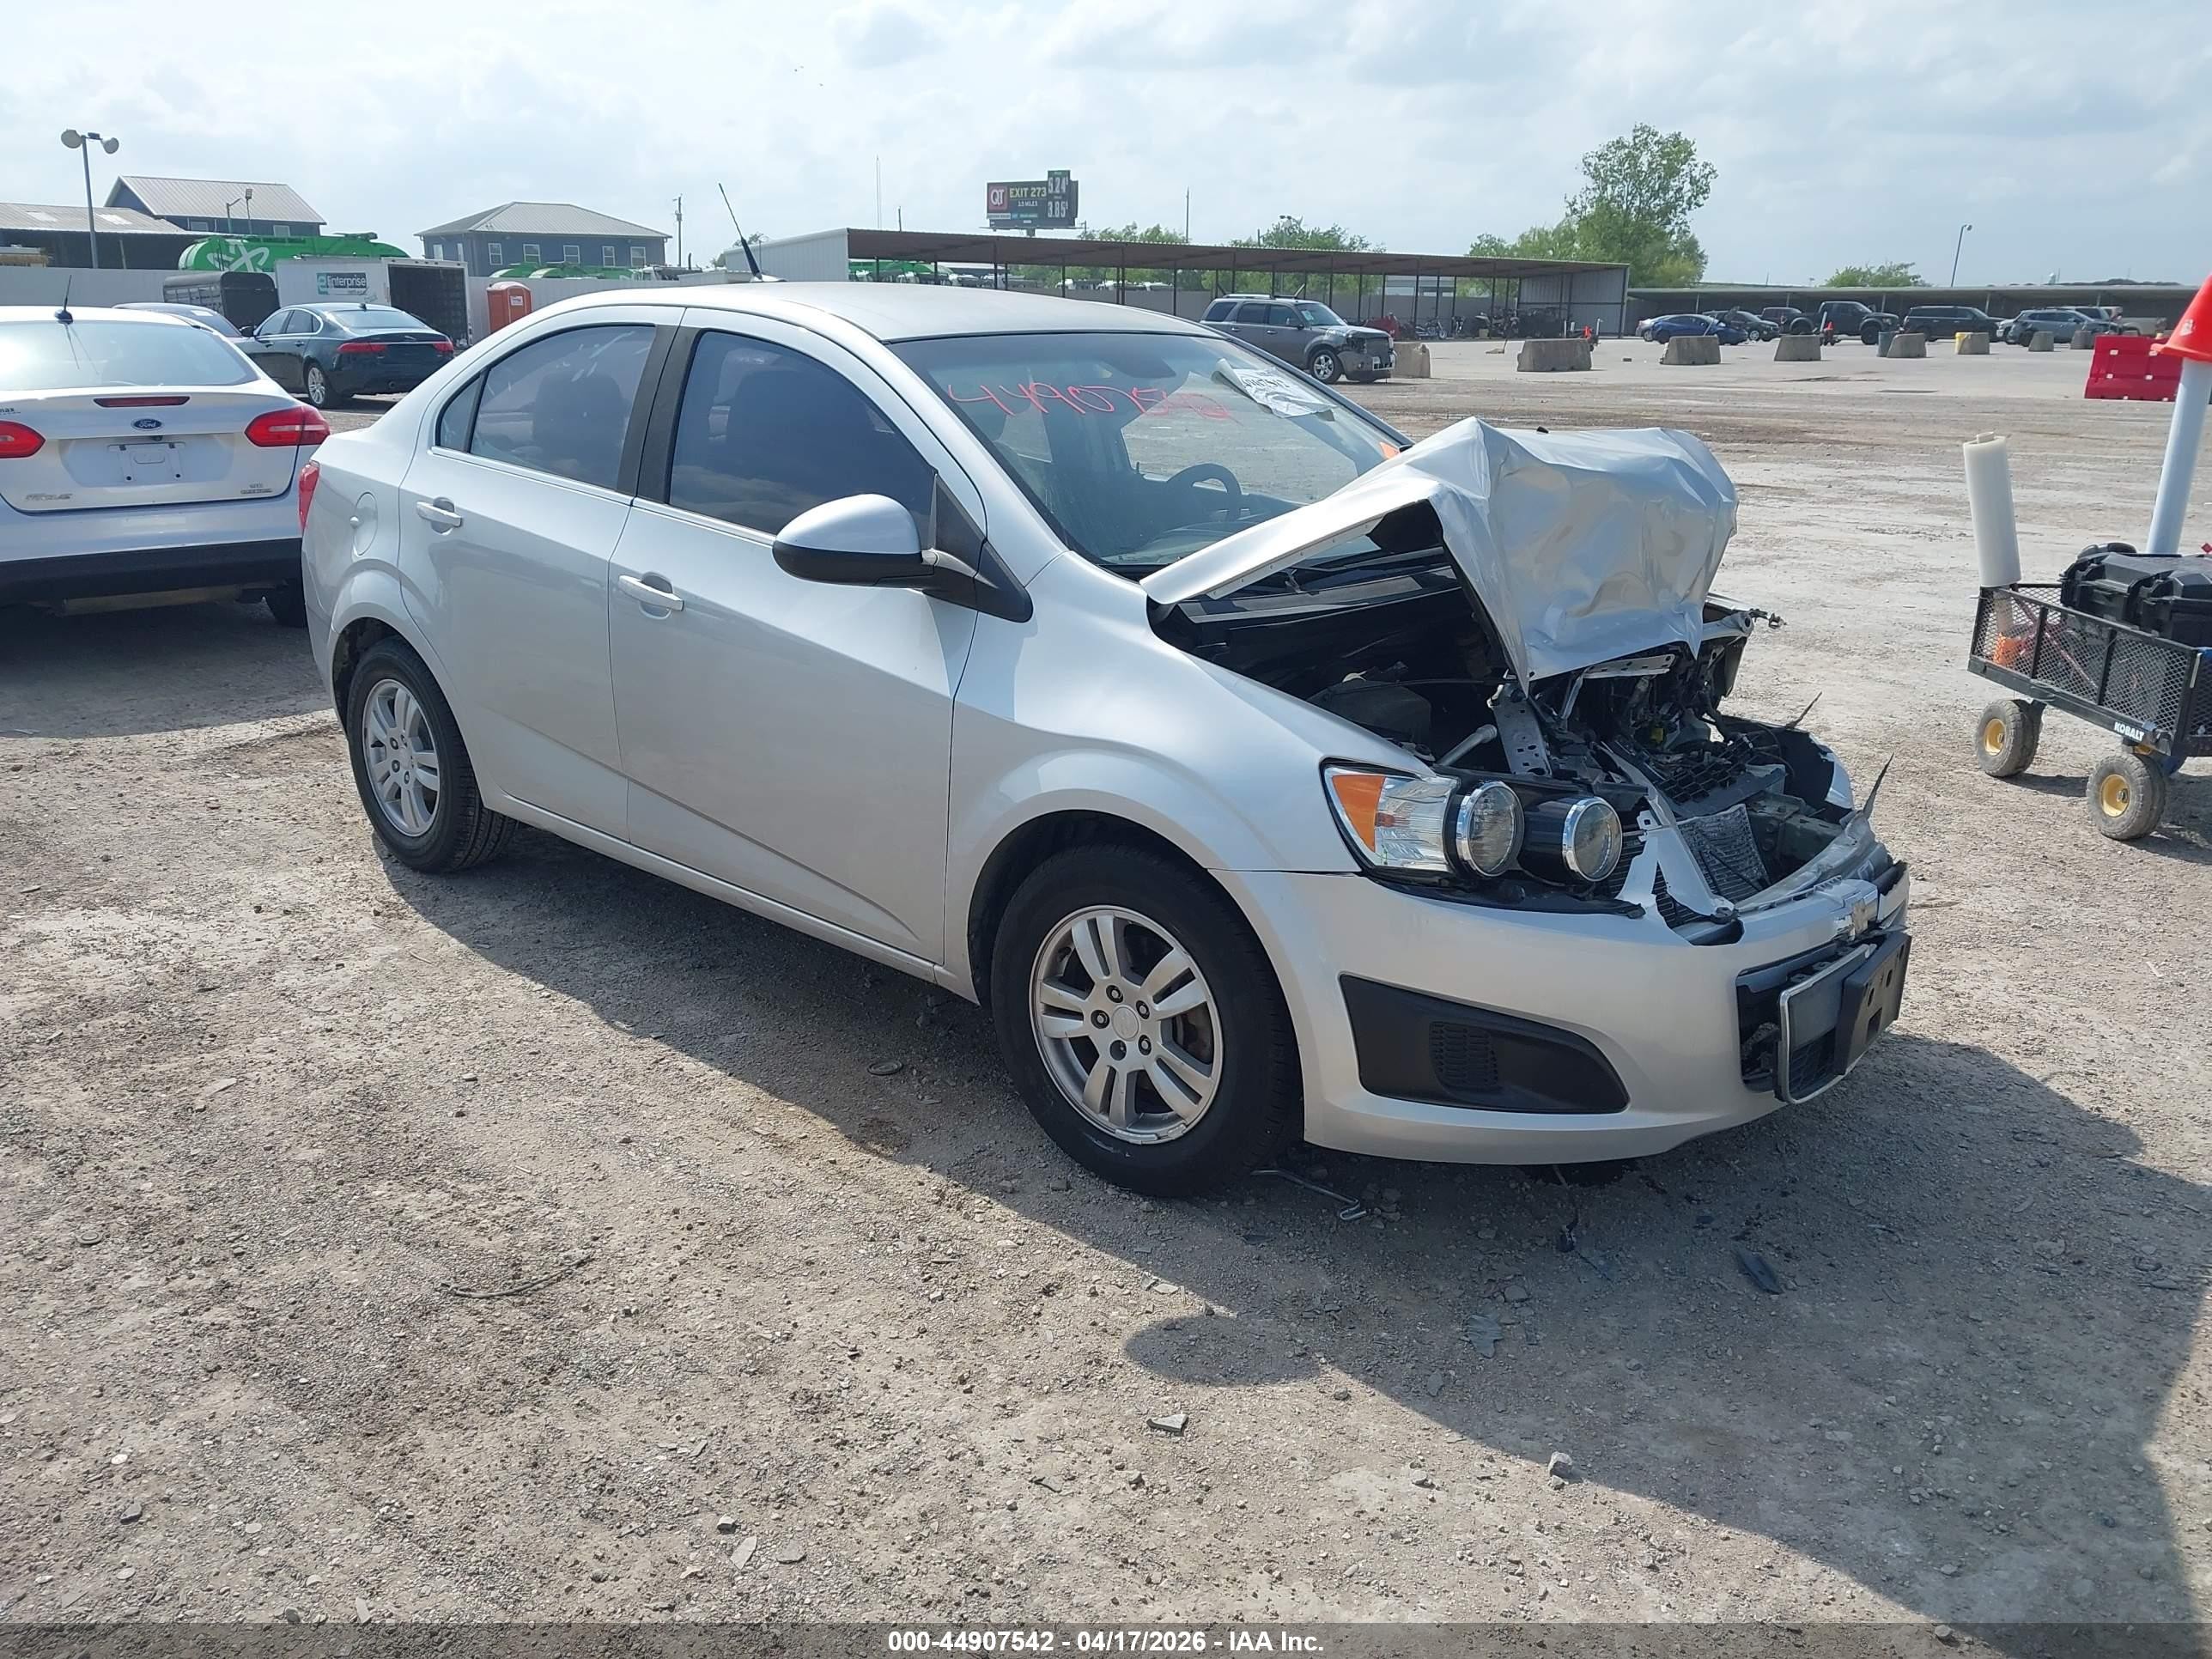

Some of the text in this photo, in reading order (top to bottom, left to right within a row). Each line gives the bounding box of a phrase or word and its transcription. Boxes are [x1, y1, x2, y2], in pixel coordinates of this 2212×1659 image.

[991, 190, 1005, 206] QT
[1009, 186, 1047, 198] EXIT 273
[327, 275, 367, 289] Enterprise
[2114, 721, 2144, 741] KOBALT
